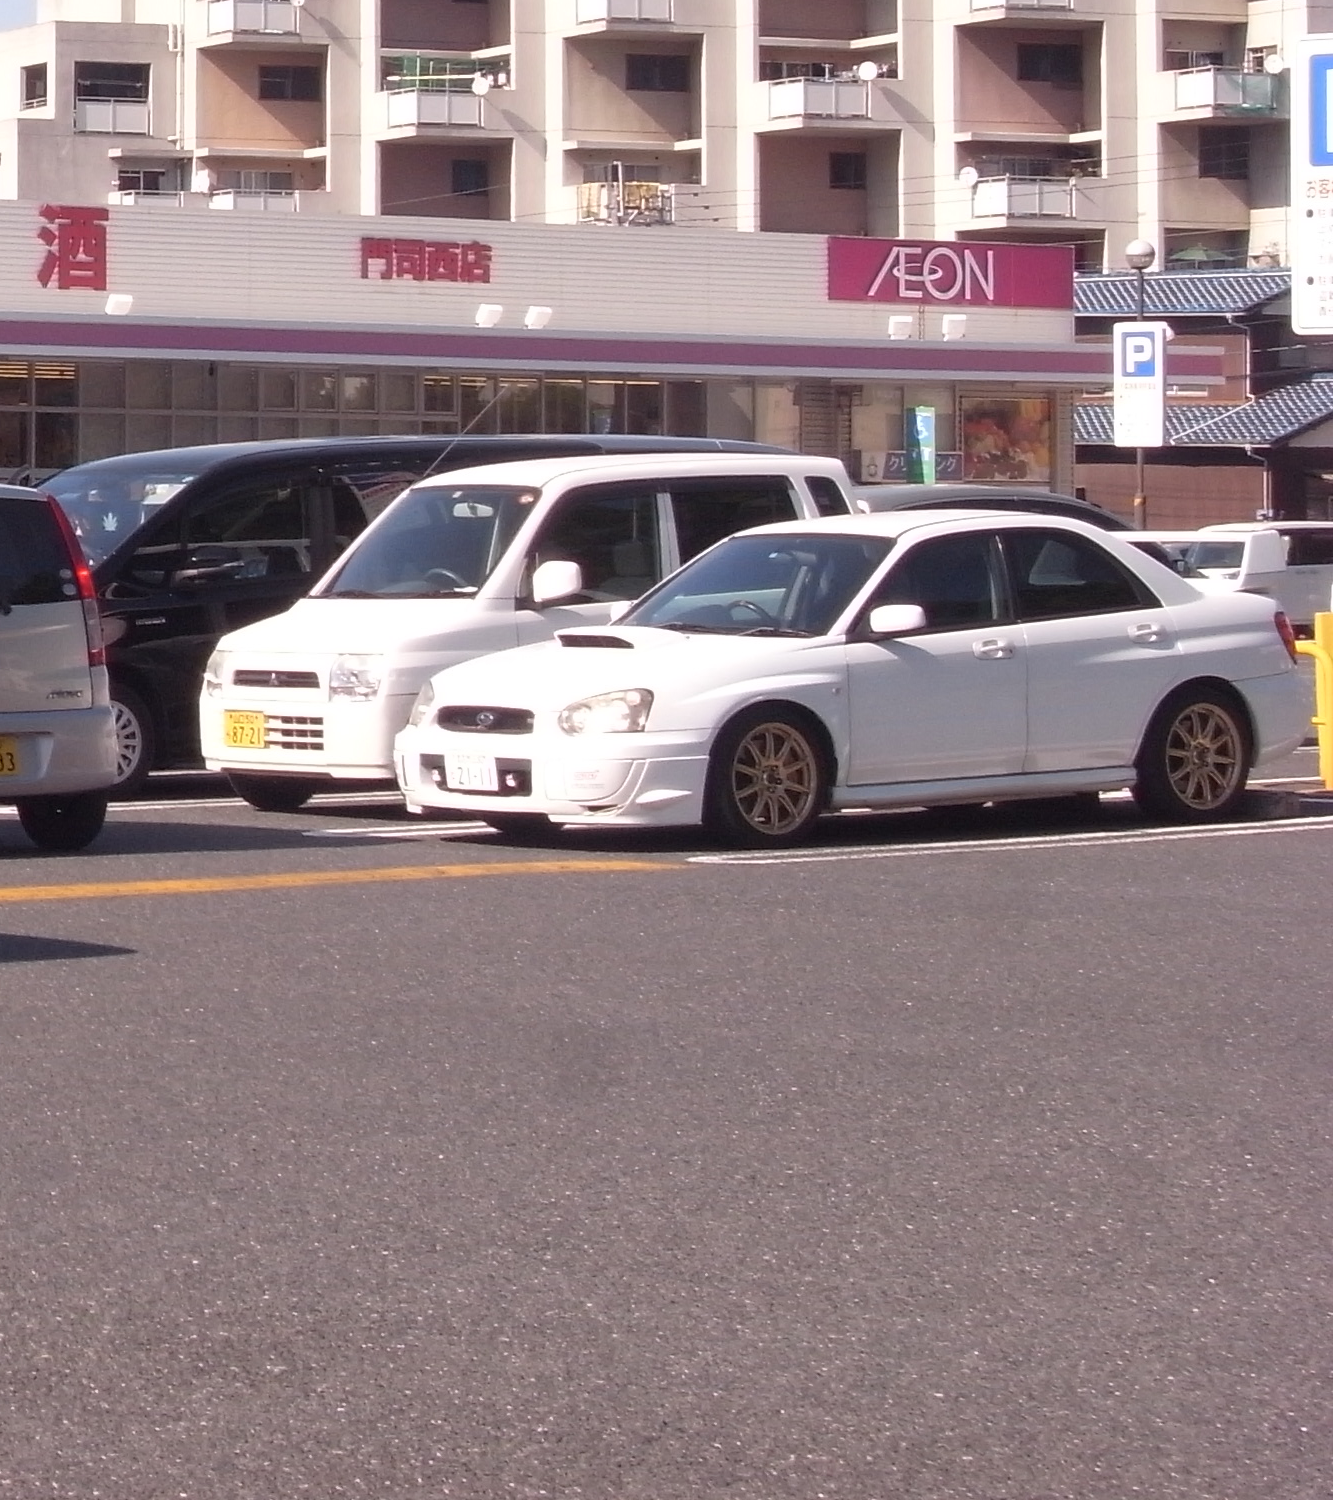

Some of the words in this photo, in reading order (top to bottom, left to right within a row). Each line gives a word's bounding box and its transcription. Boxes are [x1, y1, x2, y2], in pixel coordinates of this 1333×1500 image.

[1306, 179, 1333, 198] お客
[37, 205, 109, 290] 酒
[360, 237, 492, 283] 門司西店
[1126, 336, 1152, 373] P
